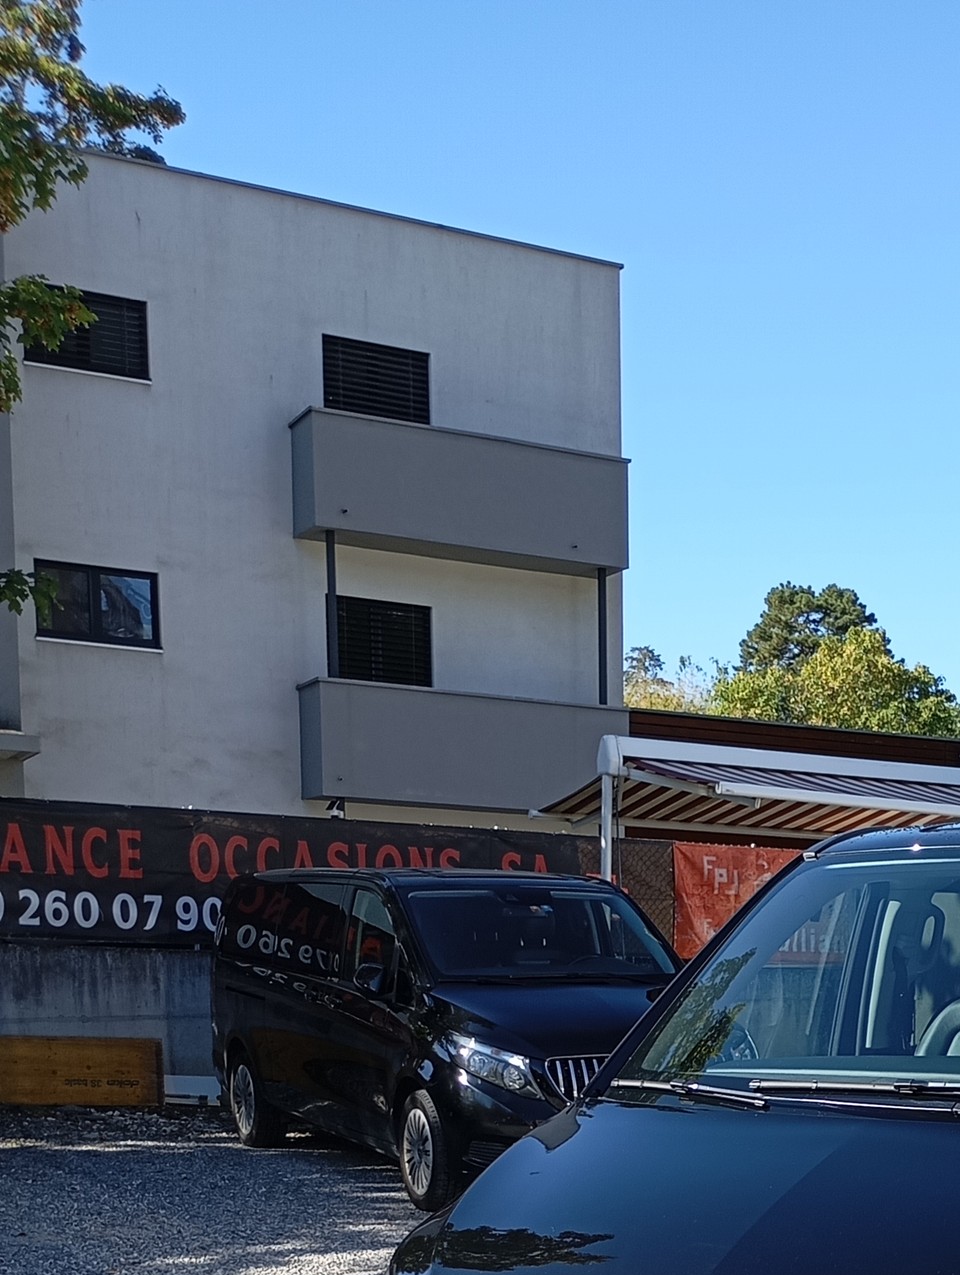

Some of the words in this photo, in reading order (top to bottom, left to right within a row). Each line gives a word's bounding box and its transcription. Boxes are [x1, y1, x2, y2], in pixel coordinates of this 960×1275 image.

[0, 822, 144, 879] ANCE
[18, 888, 100, 928] 260
[112, 893, 163, 930] 07
[175, 895, 223, 932] 90
